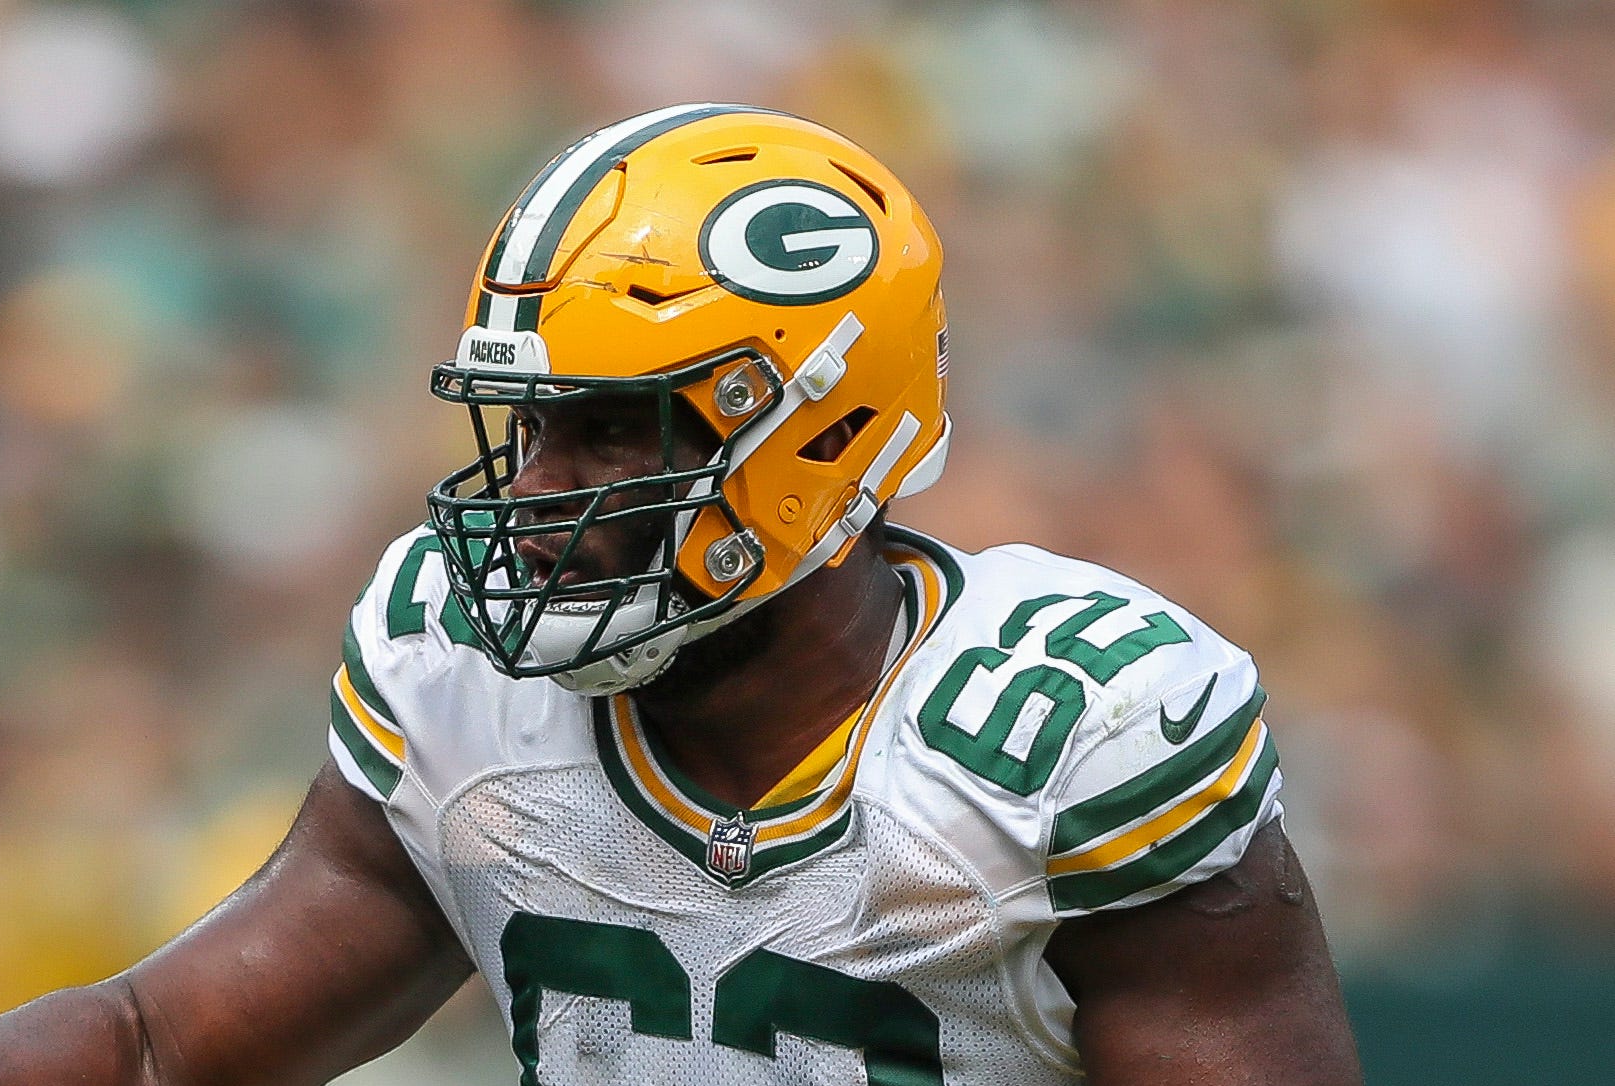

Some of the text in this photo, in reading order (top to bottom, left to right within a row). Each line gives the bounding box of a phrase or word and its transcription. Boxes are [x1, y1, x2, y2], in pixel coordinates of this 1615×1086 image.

[706, 184, 874, 298] G
[468, 338, 516, 366] PACKERS
[917, 589, 1194, 798] 62
[713, 843, 745, 873] NFL
